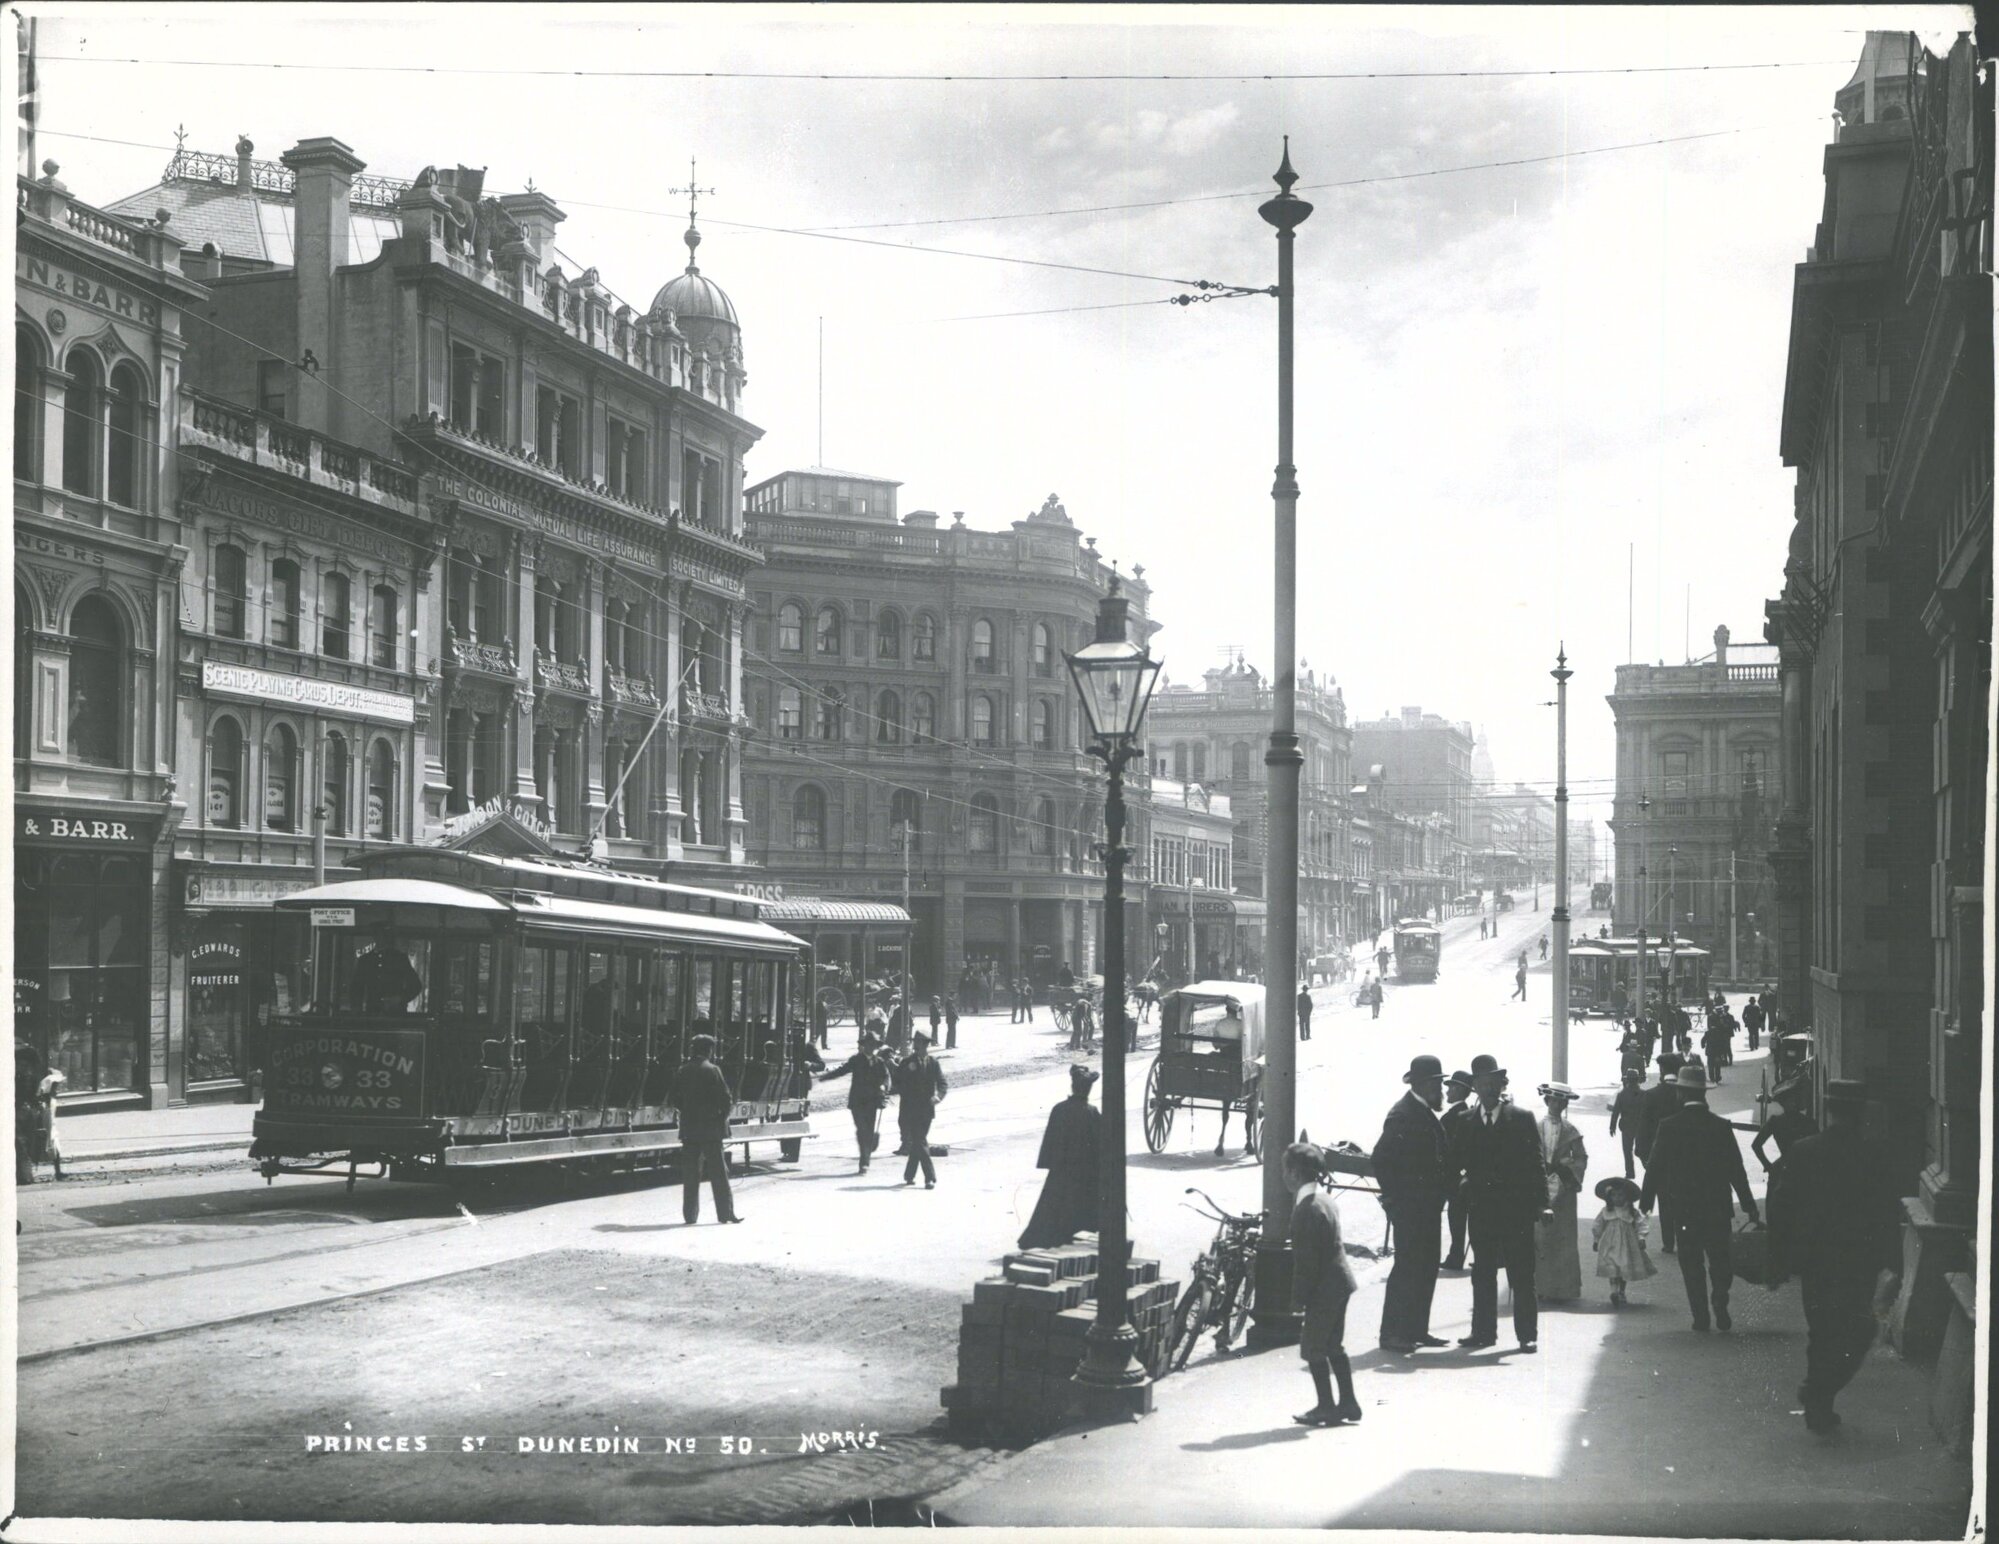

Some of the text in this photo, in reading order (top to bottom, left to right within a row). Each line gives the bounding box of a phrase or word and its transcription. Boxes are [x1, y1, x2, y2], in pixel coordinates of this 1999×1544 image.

[15, 255, 159, 327] N & BARR
[438, 476, 739, 592] THE COLONIAL MUTUAL LIFE ASSURANCE SOCIETY LIMITED
[205, 663, 248, 689] SCENIC
[250, 672, 293, 697] PLAYING
[294, 680, 328, 703] CARDS
[24, 818, 135, 841] & BARR.
[505, 799, 512, 813] &
[514, 804, 552, 843] GOTCH
[191, 975, 240, 986] FRUITERER
[15, 1006, 31, 1014] RR
[271, 1038, 414, 1075] CORPORATION
[356, 1069, 392, 1089] 33
[277, 1089, 403, 1110] TRAMWAYS
[510, 1113, 583, 1131] DUNEDN
